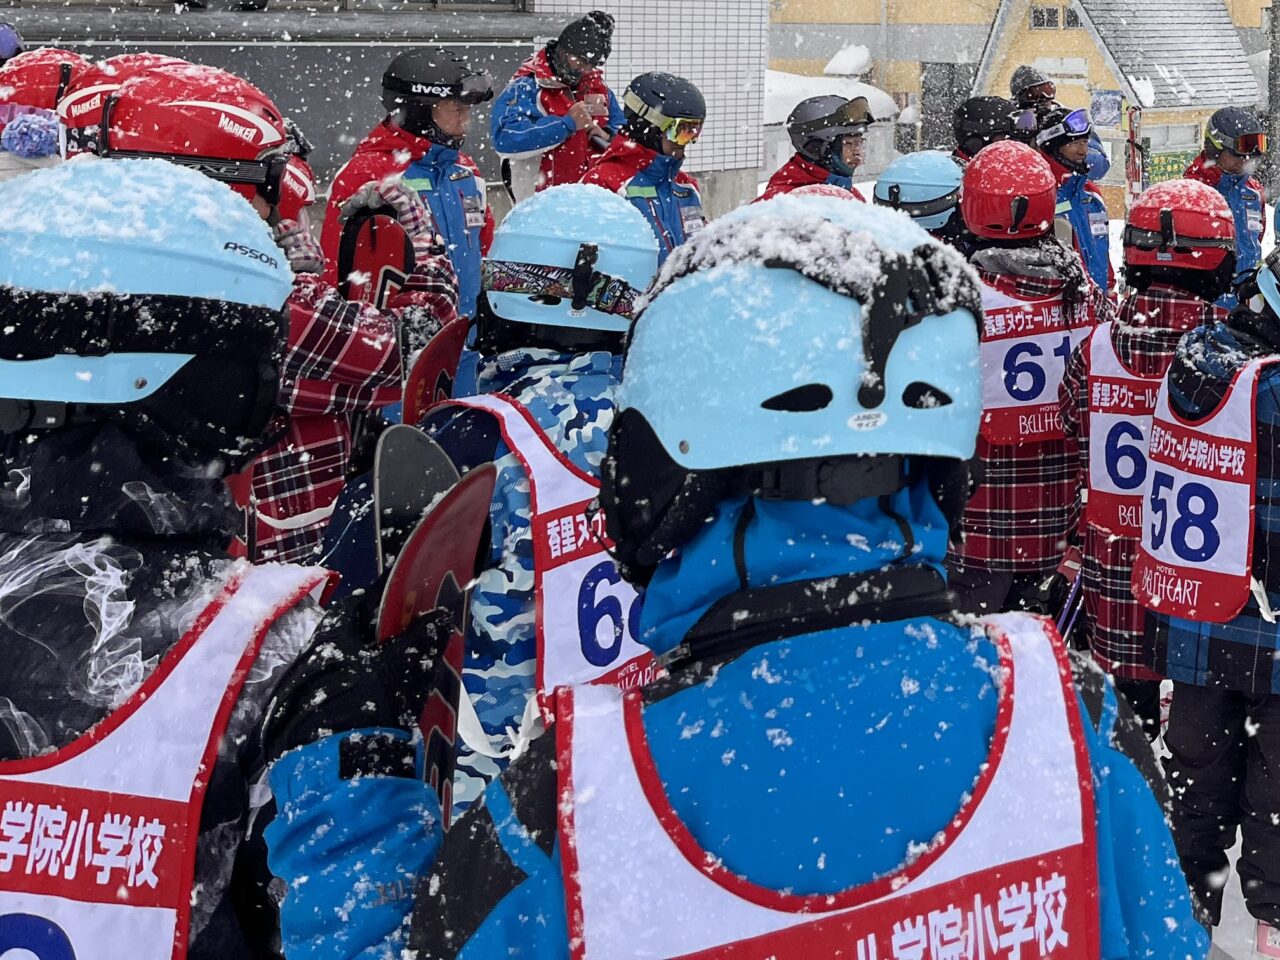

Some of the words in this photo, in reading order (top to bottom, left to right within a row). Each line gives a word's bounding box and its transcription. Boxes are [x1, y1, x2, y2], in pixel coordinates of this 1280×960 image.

[411, 83, 453, 97] uvex
[71, 93, 101, 118] MARKER
[218, 112, 257, 142] MARKER
[223, 241, 278, 269] ASSOR
[1150, 471, 1221, 562] 58
[1156, 564, 1178, 576] HOTEL
[578, 561, 645, 667] 6
[0, 800, 166, 889] 学院小学校
